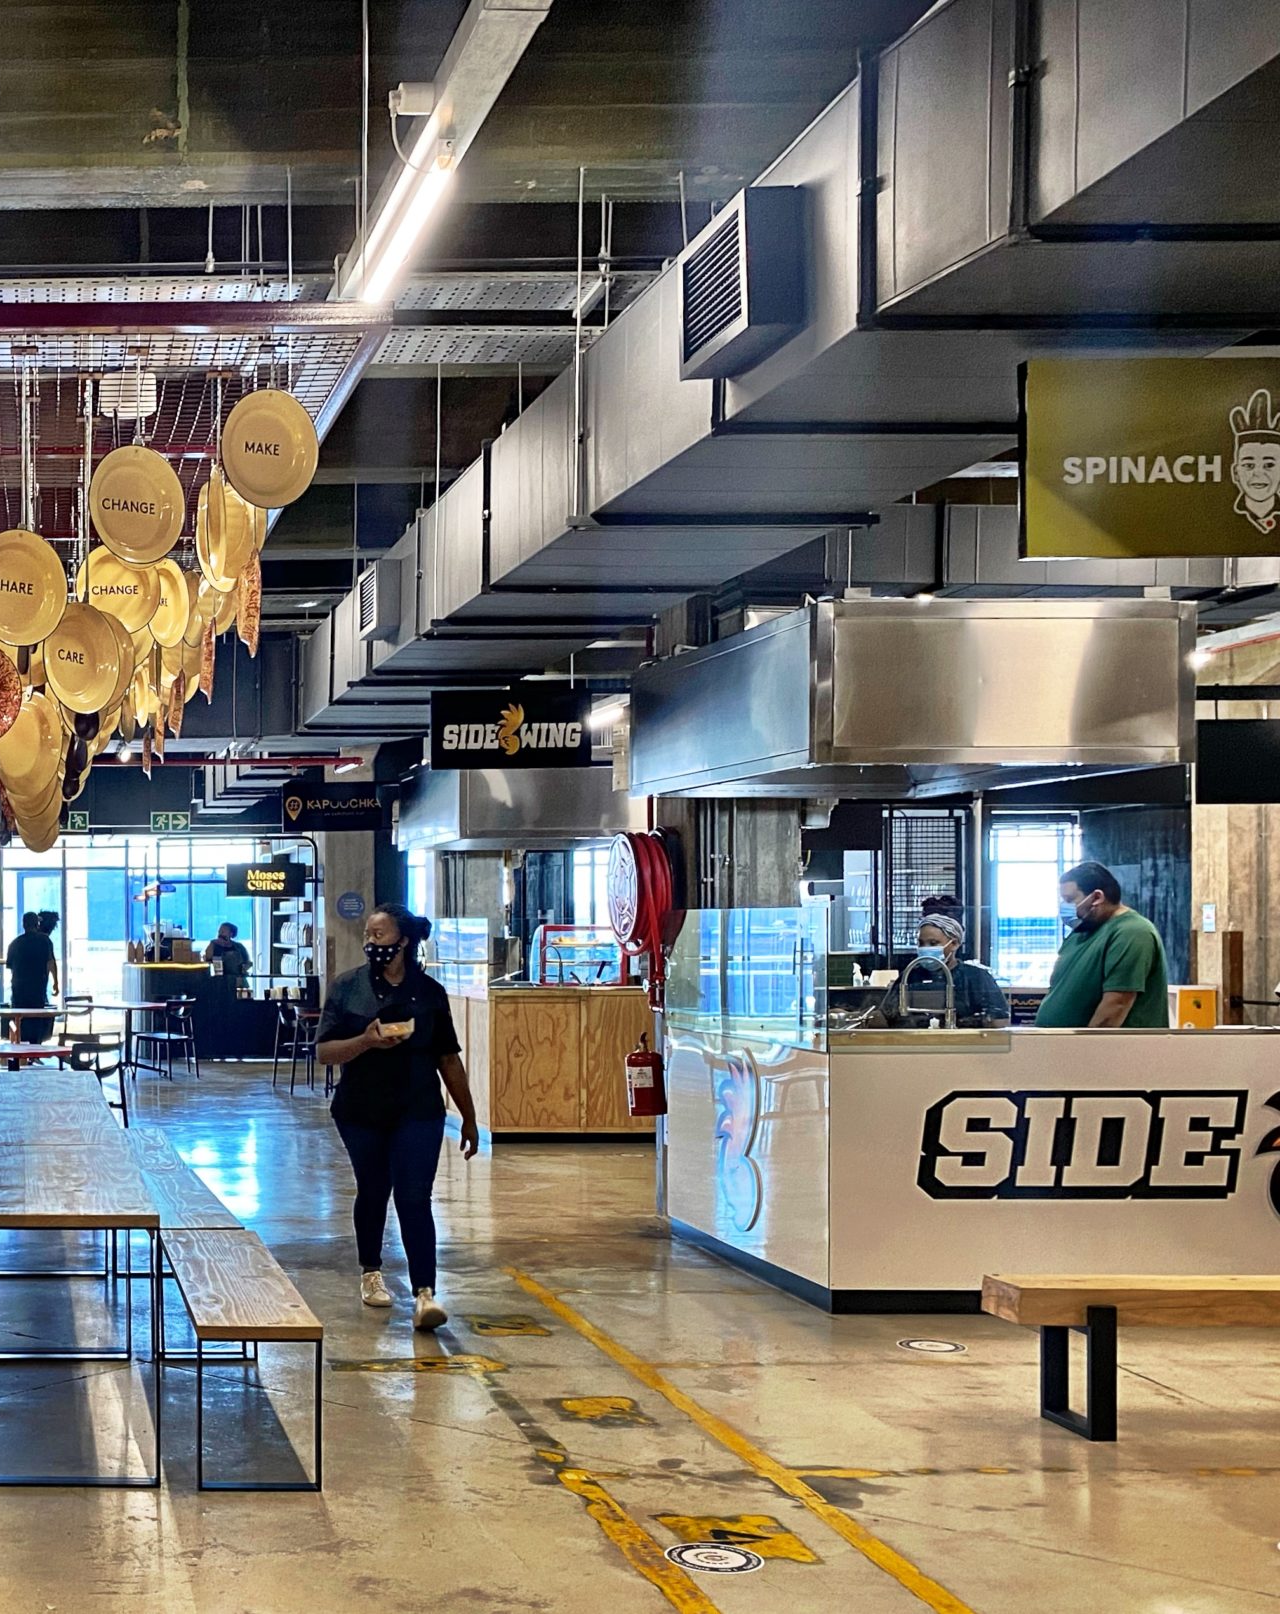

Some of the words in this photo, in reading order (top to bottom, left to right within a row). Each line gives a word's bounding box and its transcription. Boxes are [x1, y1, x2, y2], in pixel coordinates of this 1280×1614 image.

[244, 441, 280, 456] MAKE
[1063, 455, 1222, 484] SPINACH
[101, 497, 156, 515] CHANGE
[91, 585, 139, 596] CHANGE
[57, 648, 85, 665] CARE
[442, 723, 500, 750] SIDE
[520, 722, 582, 749] WING
[247, 869, 286, 881] Moses
[247, 880, 285, 891] Coffee
[916, 1089, 1249, 1200] SIDE
